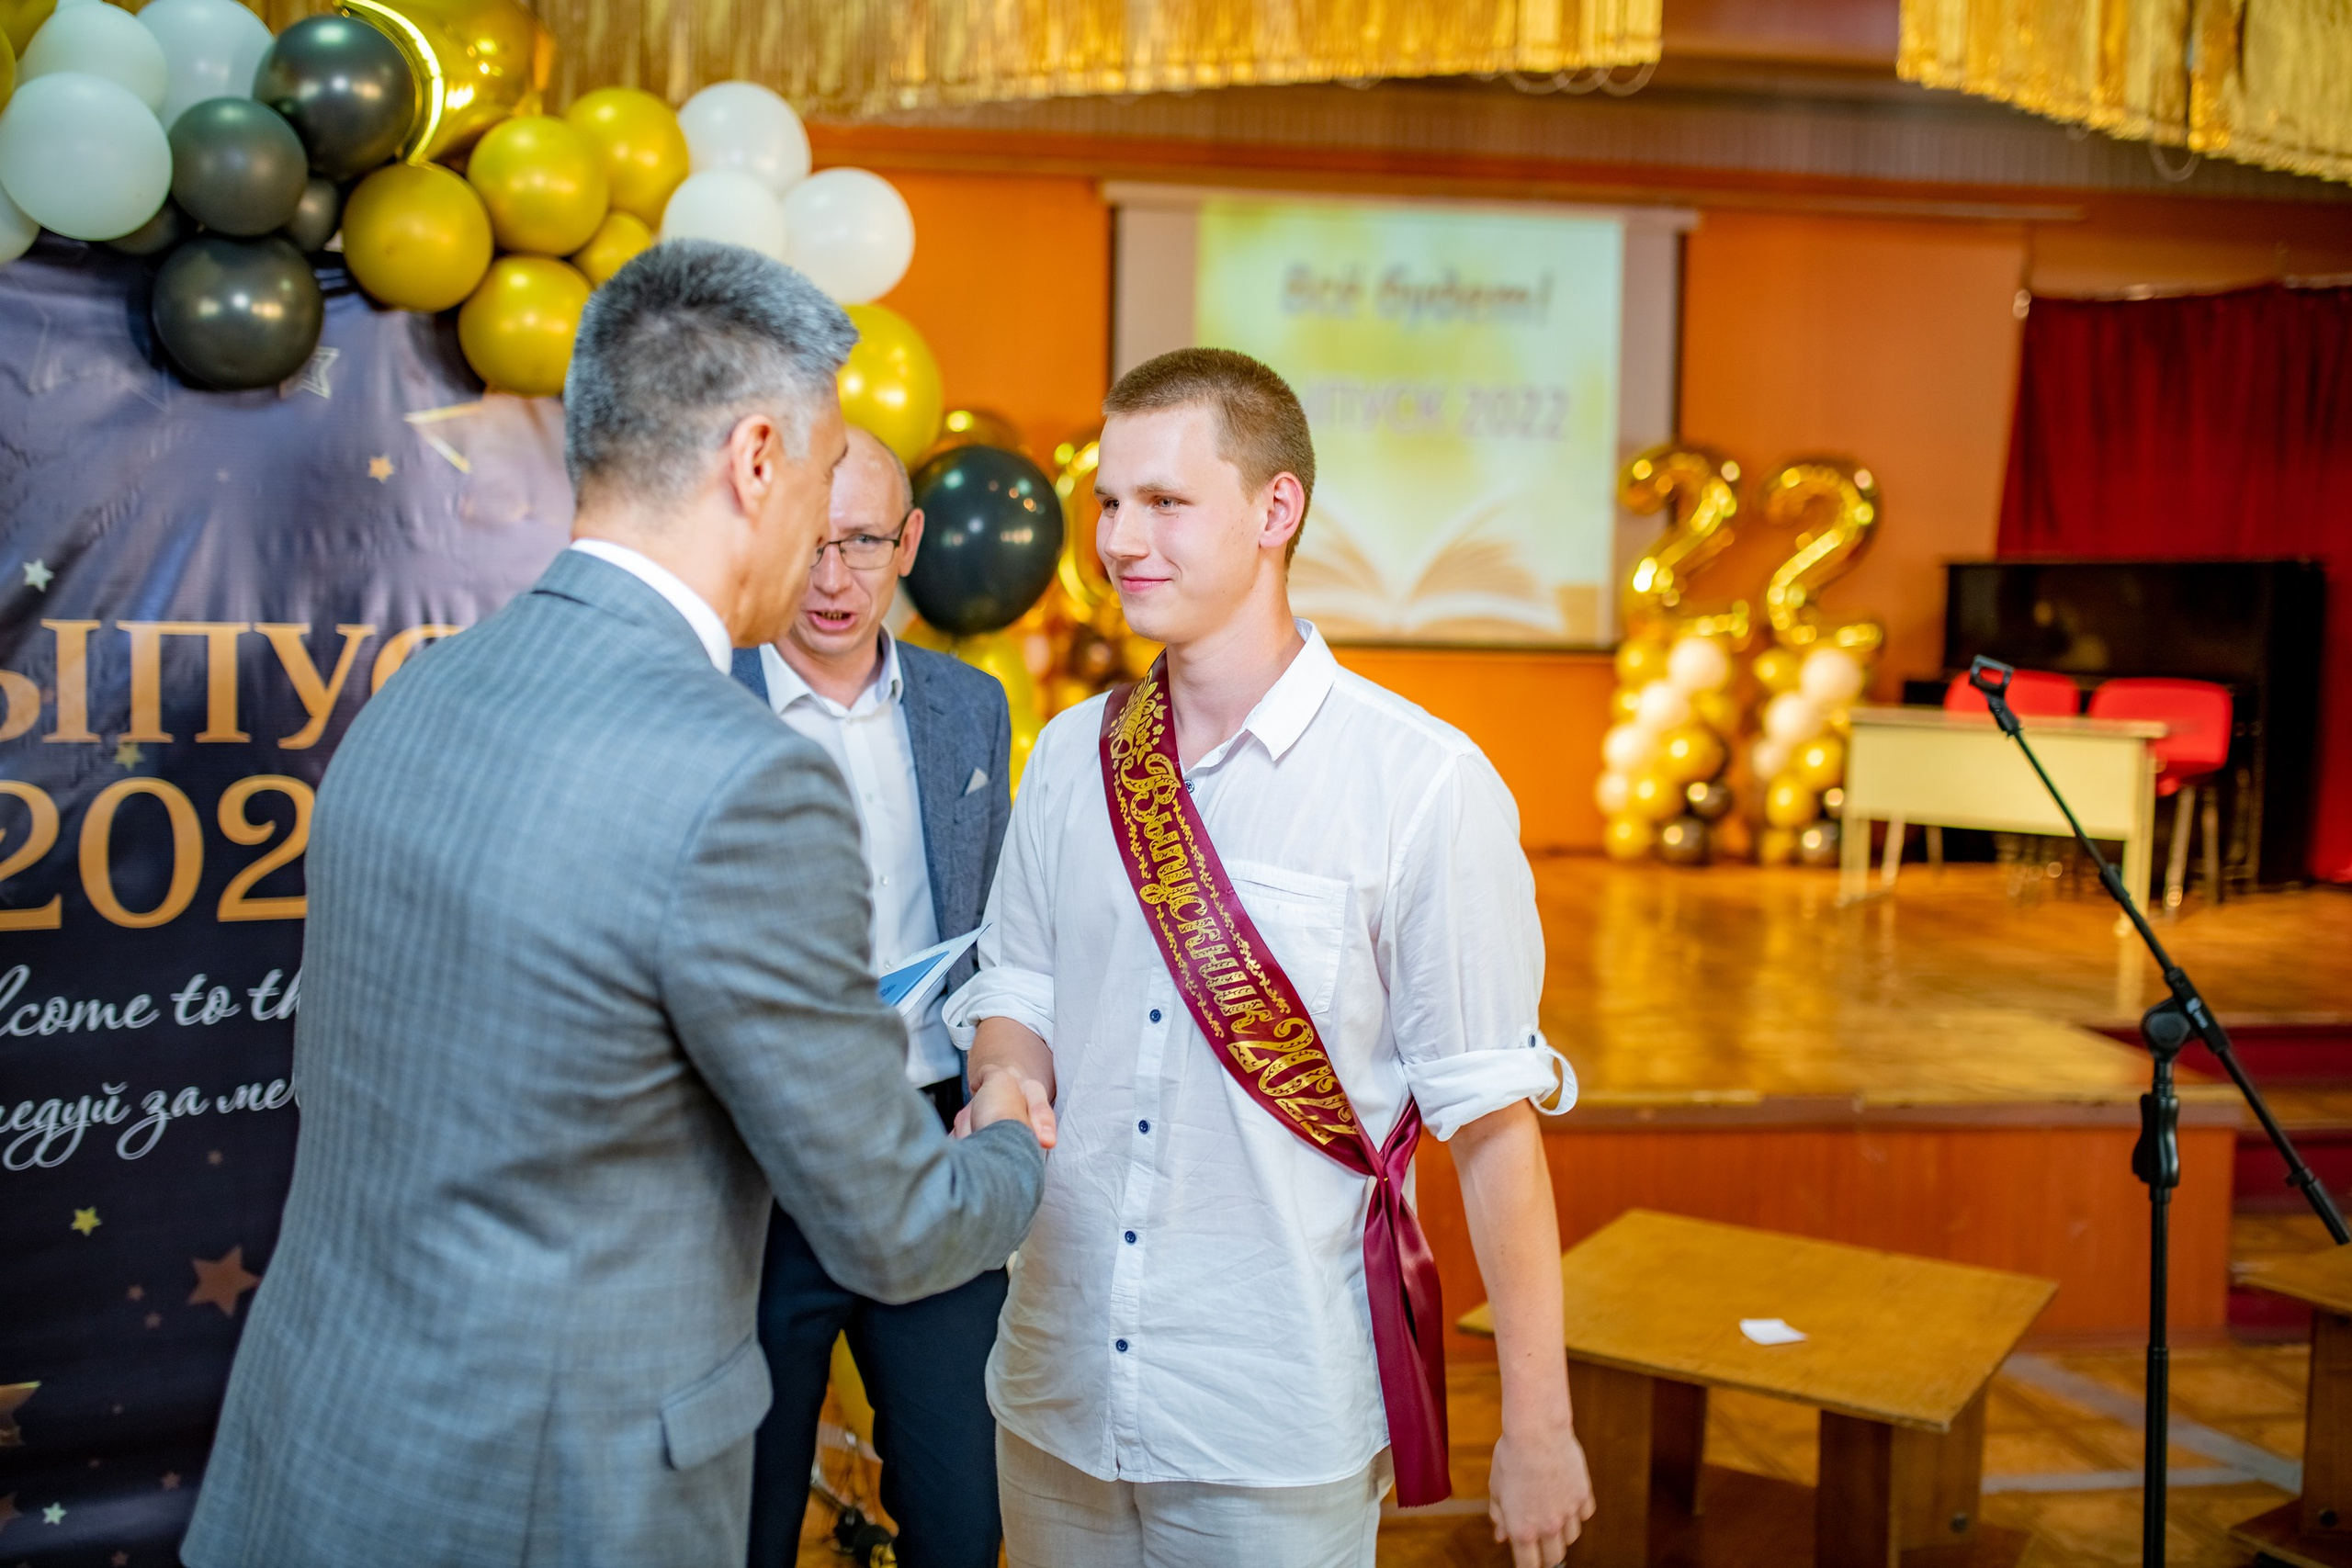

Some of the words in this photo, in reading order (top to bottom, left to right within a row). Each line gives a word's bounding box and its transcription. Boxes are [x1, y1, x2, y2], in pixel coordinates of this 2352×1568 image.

[1458, 381, 1571, 440] 2022
[170, 973, 241, 1026] to
[116, 1086, 210, 1160] за
[216, 1072, 301, 1113] ме
